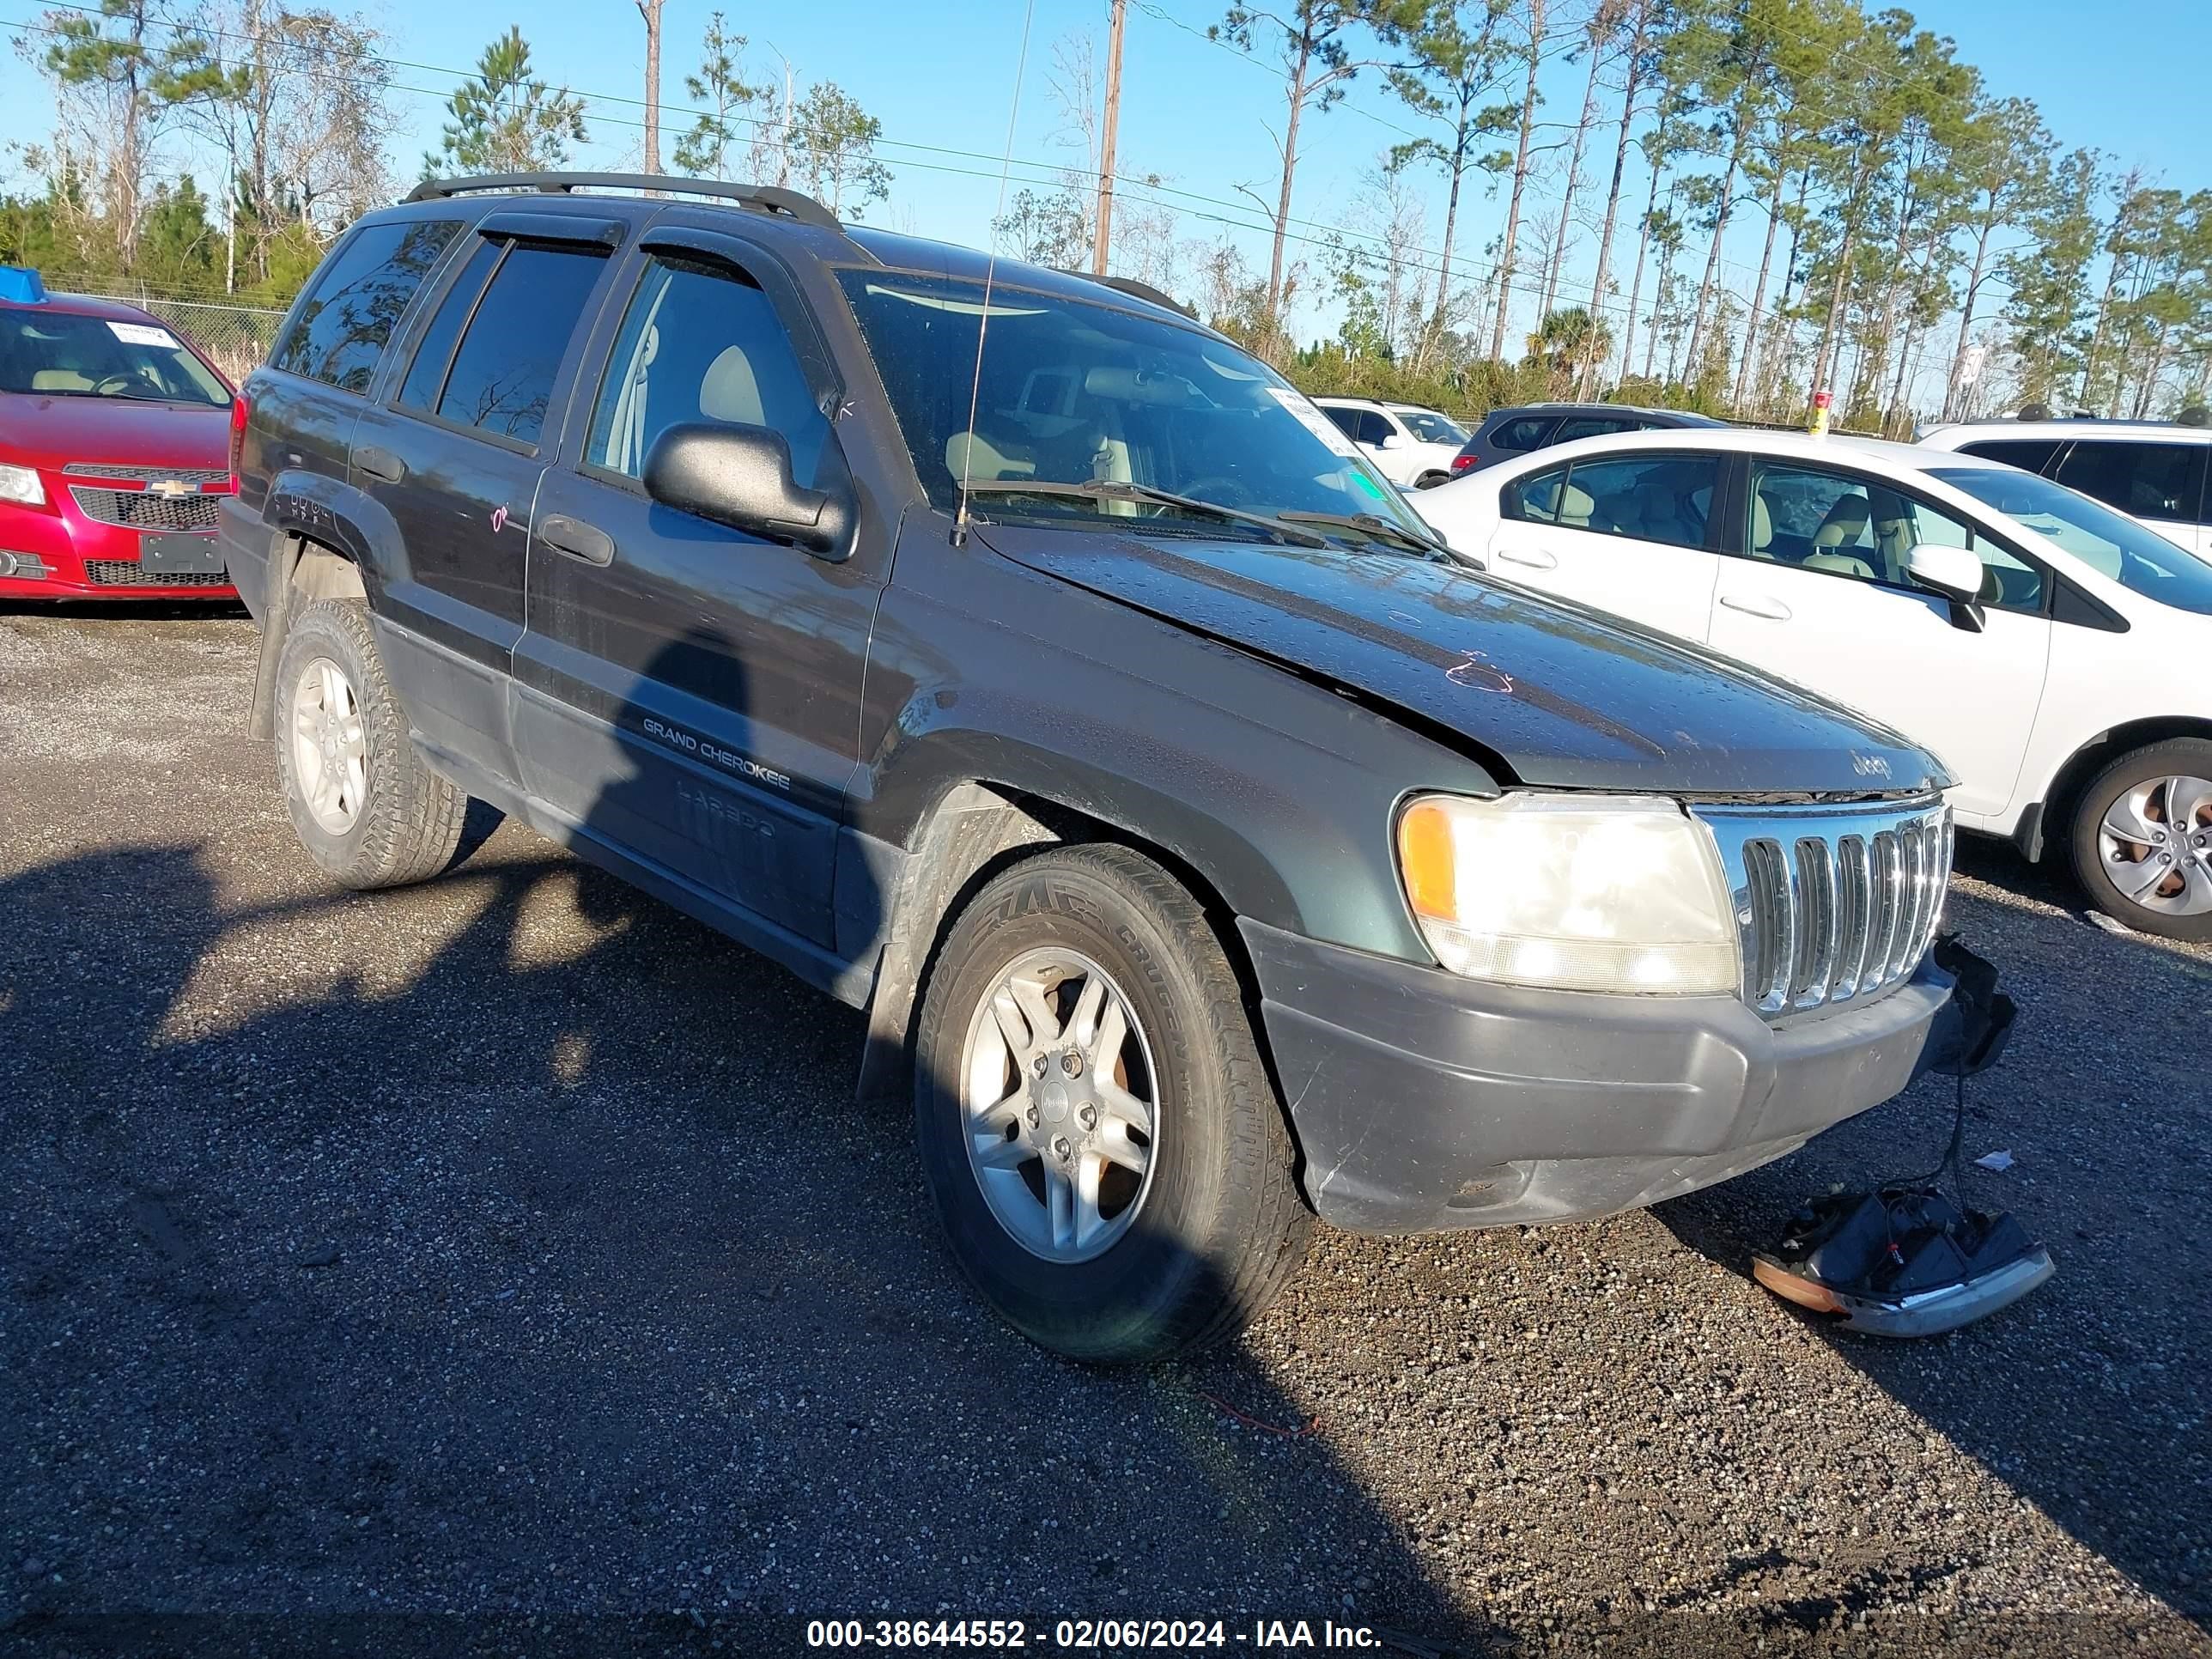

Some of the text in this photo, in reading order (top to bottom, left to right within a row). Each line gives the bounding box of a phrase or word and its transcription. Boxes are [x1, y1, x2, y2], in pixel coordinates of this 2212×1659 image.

[643, 717, 791, 792] GRAND CHEROKEE
[1849, 749, 1893, 781] Jeep
